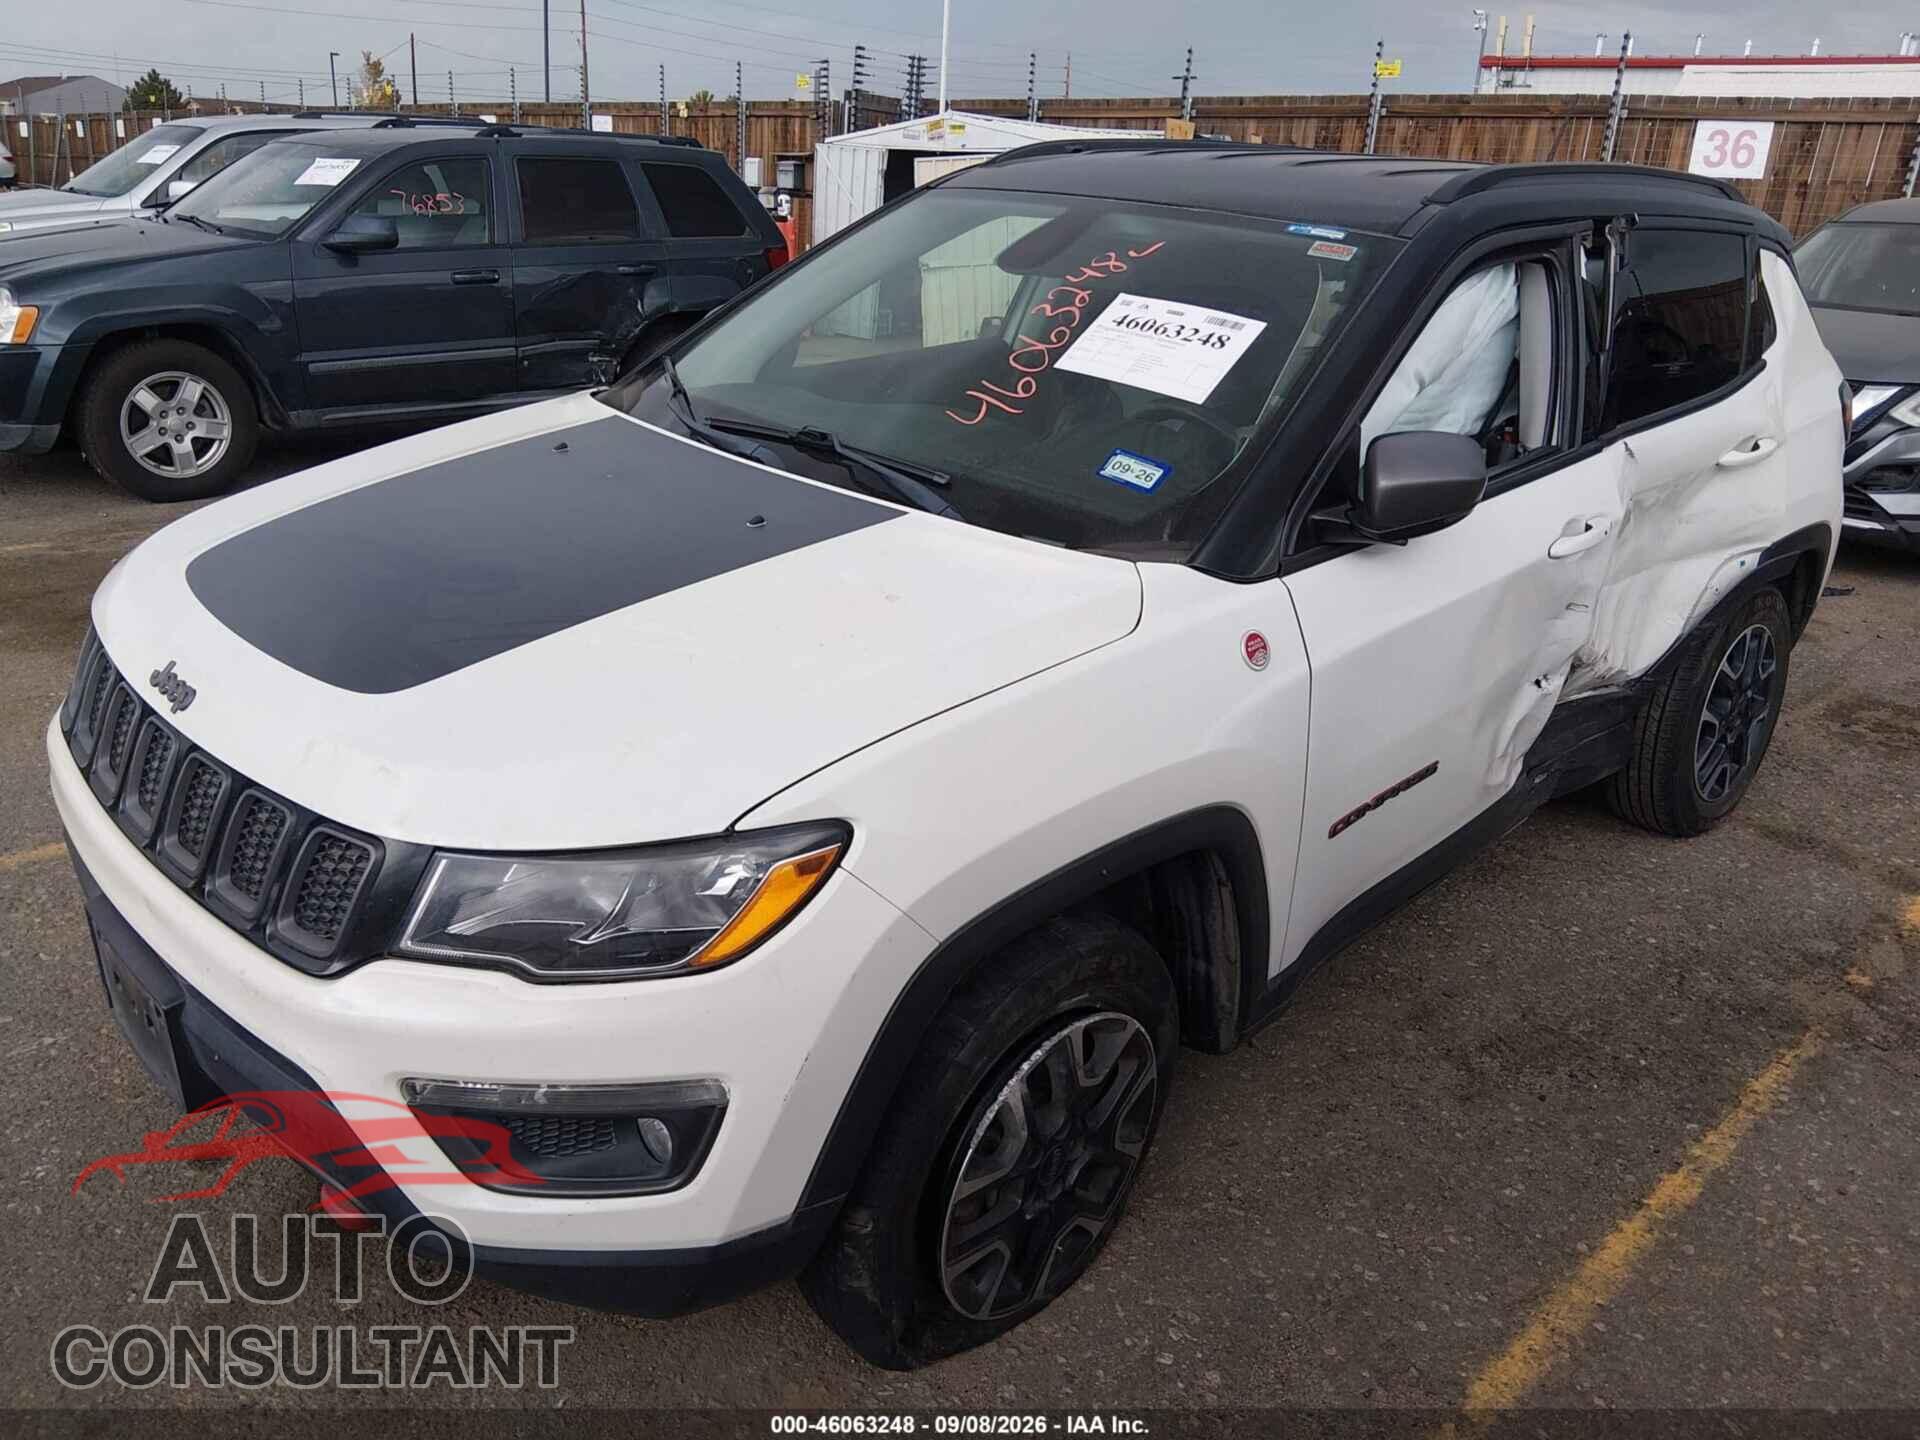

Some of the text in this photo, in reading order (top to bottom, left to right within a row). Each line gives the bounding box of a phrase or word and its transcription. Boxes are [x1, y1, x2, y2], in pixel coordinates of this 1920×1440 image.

[1703, 128, 1758, 168] 36
[389, 189, 465, 218] 76853
[1112, 313, 1231, 350] 46063248
[1111, 460, 1131, 473] 09
[1135, 469, 1156, 483] 26
[149, 660, 197, 714] Jeep
